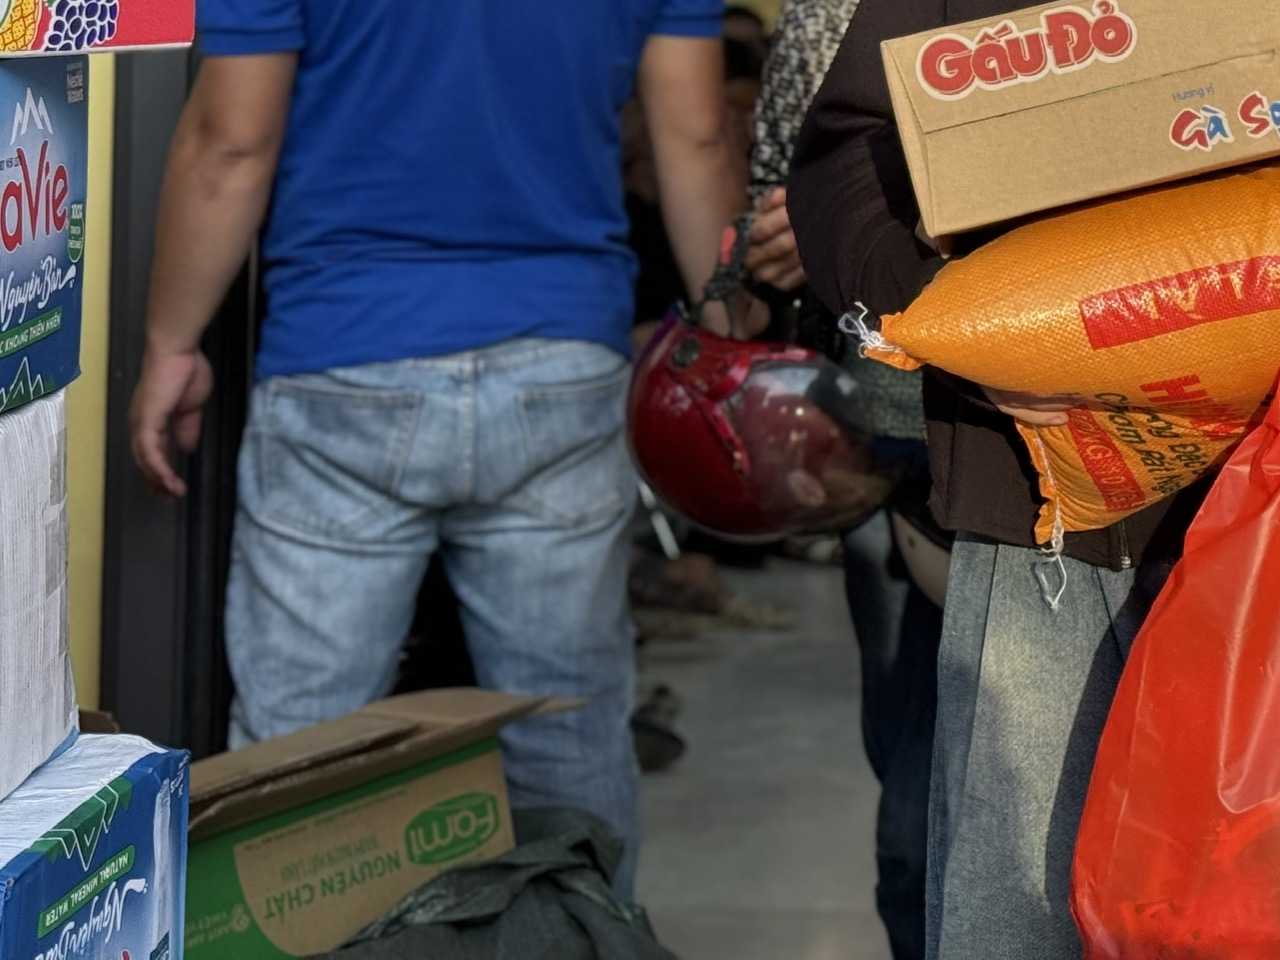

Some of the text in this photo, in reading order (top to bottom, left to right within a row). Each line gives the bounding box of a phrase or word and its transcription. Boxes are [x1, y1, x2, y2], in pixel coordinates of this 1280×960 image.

[1170, 105, 1230, 149] Gà
[70, 874, 99, 907] MINERAL
[45, 901, 69, 927] WATER
